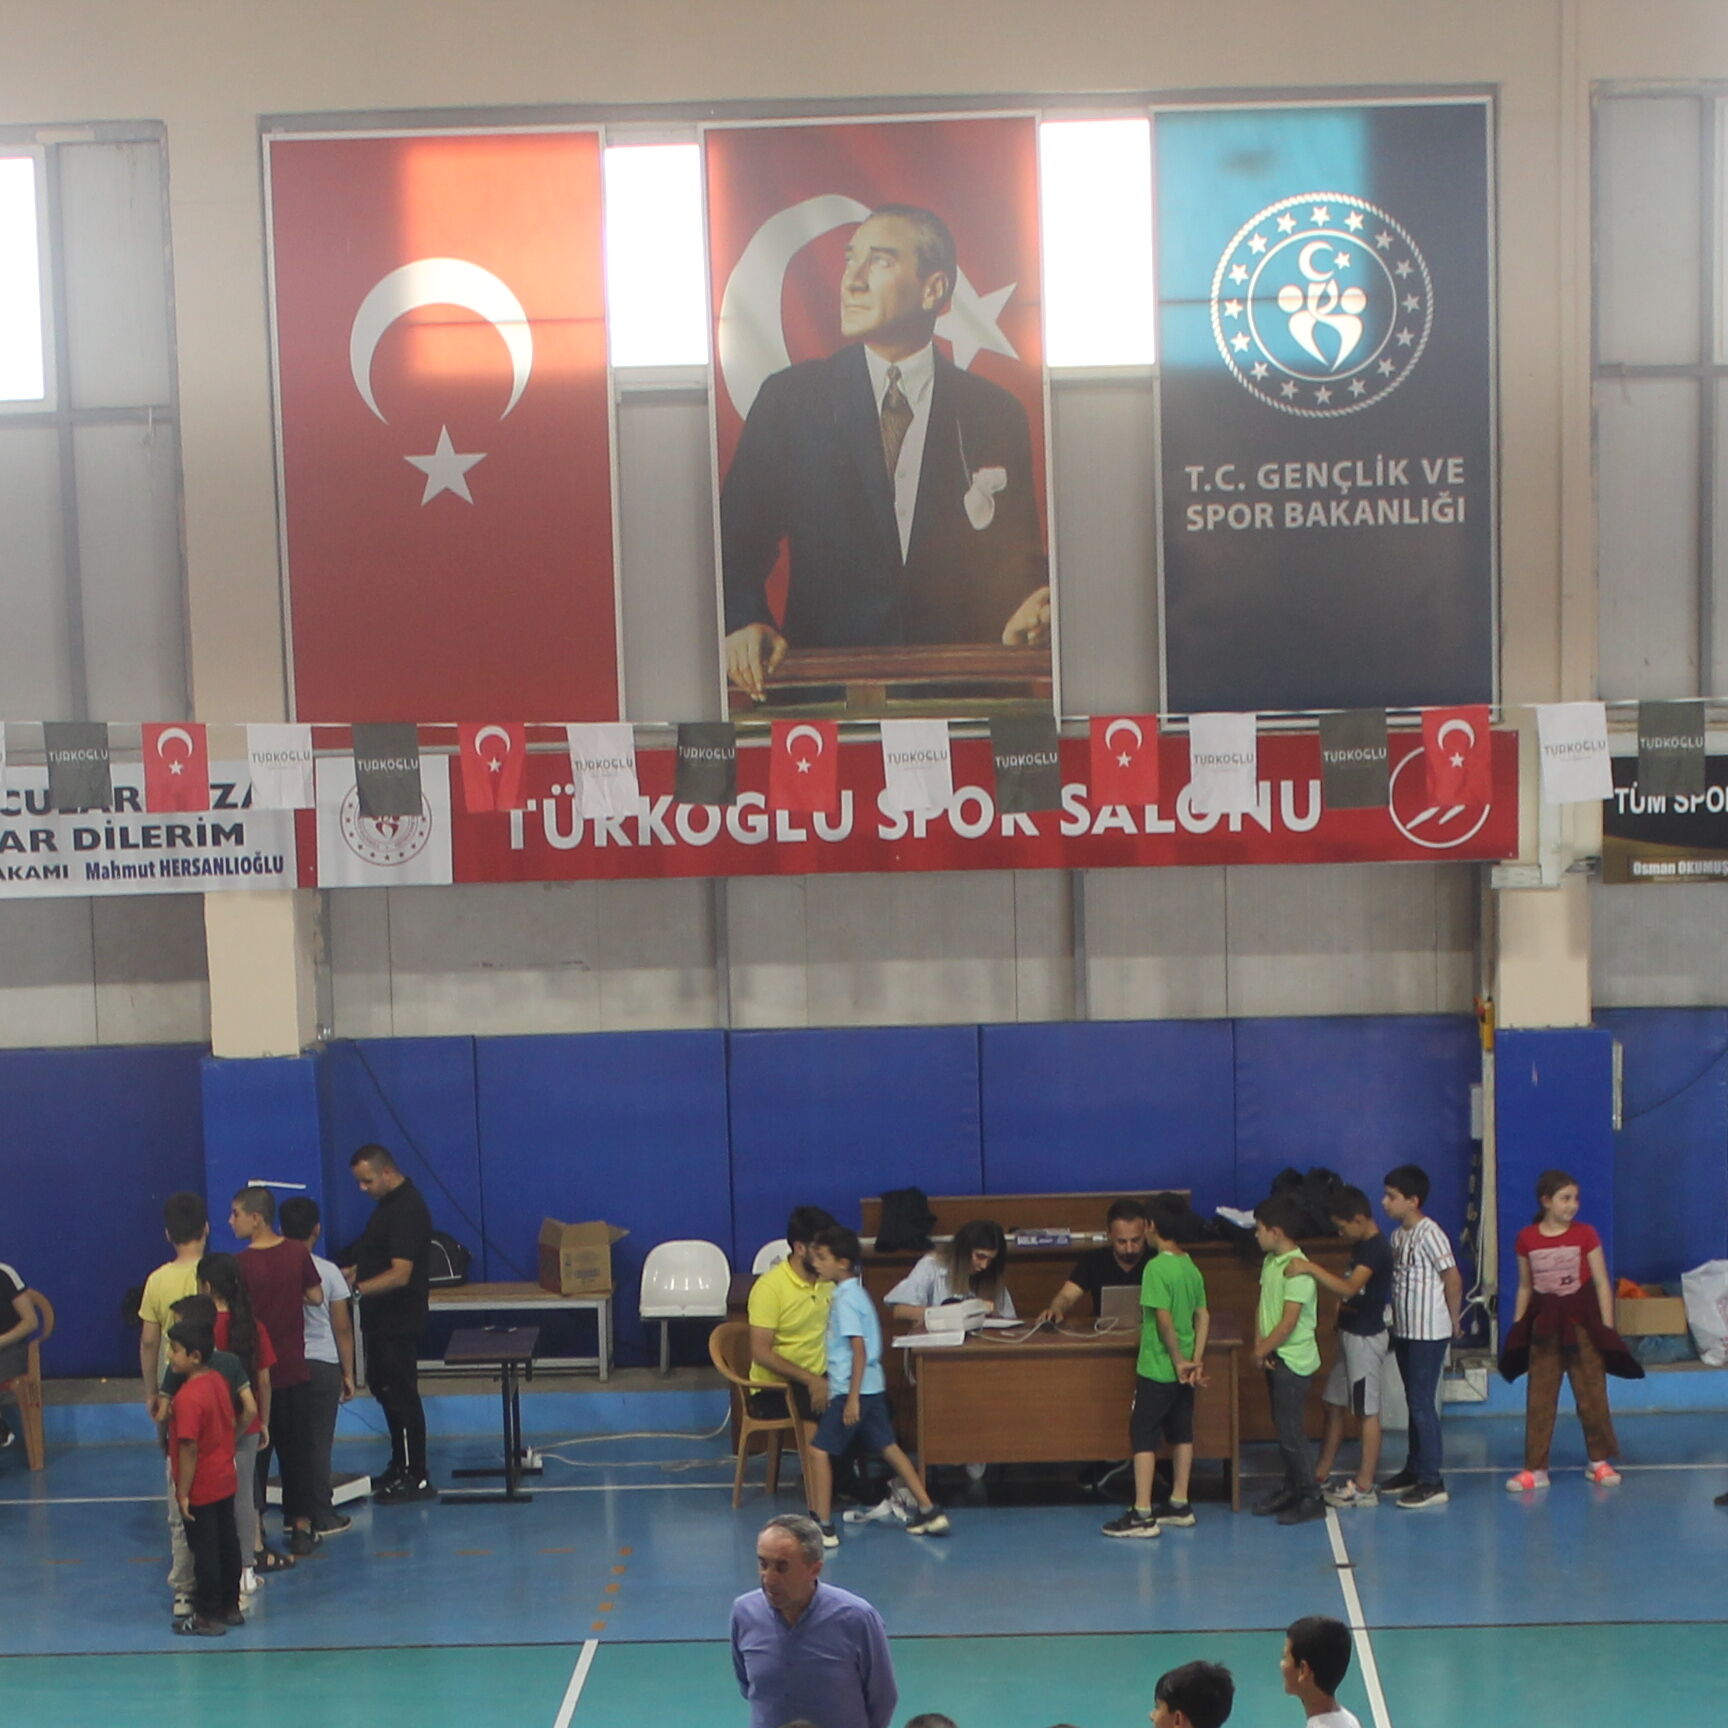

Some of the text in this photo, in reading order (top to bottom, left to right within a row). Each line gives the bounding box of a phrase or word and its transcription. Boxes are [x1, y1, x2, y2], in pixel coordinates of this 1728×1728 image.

[1184, 454, 1465, 494] T.C. GENÇLİK VE
[1186, 490, 1465, 532] SPOR BAKANLIĞI
[72, 816, 245, 852] DİLERİM
[84, 859, 157, 882] Mahmut
[158, 852, 285, 879] HERSANLIOĞLU
[1633, 860, 1676, 875] Osman
